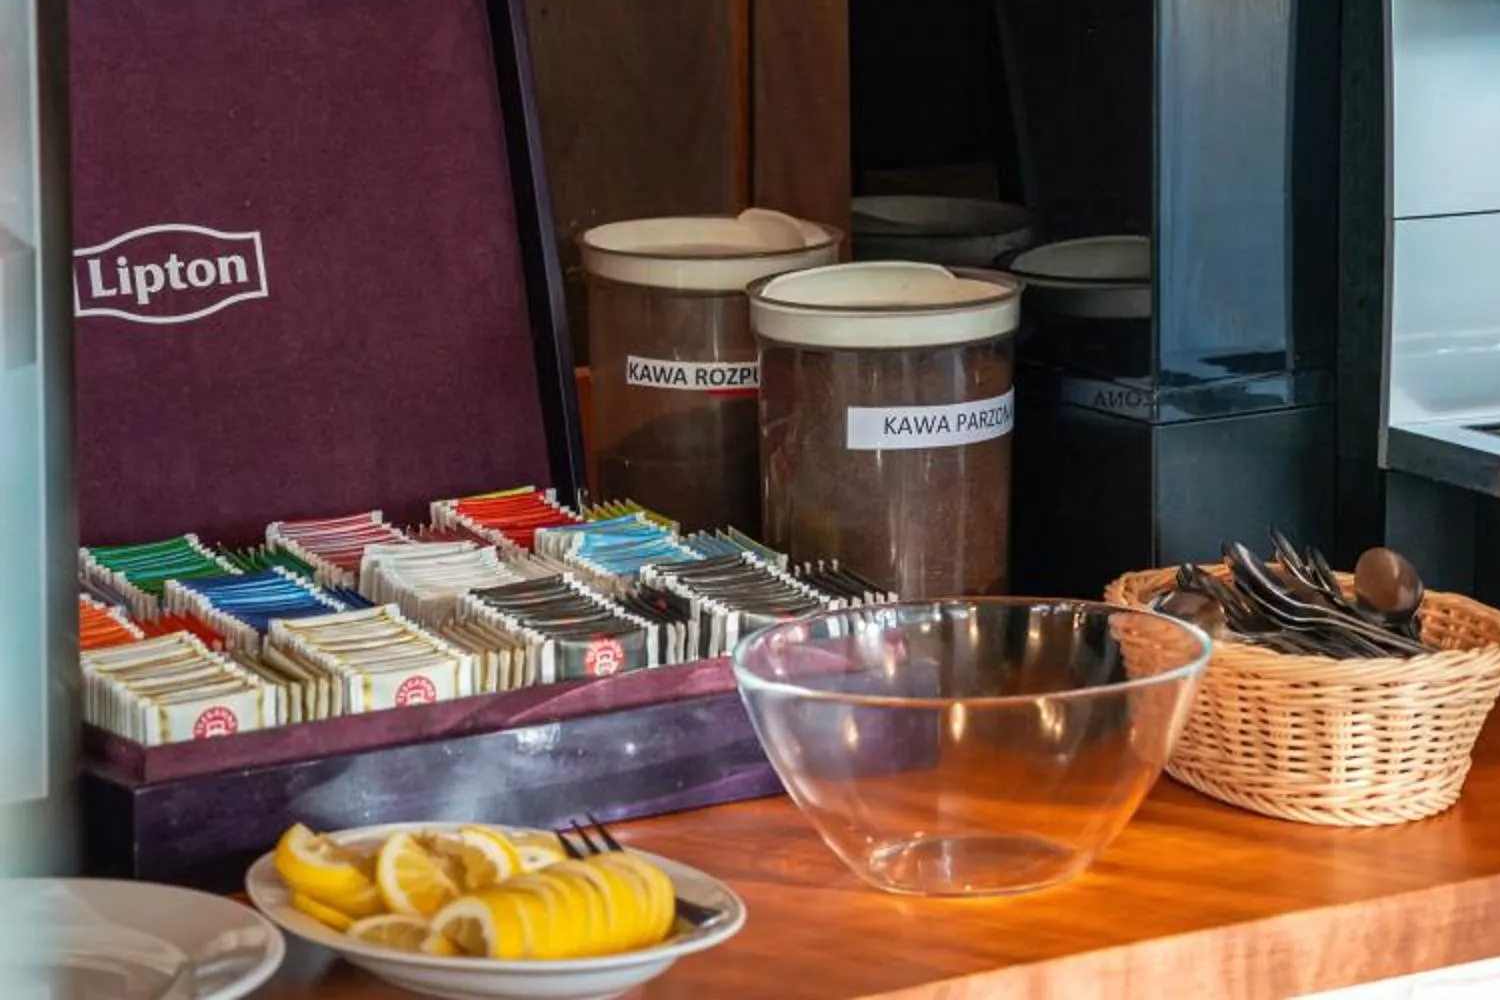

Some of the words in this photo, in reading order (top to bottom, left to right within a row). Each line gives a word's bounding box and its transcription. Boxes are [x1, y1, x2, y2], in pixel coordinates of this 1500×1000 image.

[87, 253, 249, 305] Lipton
[628, 362, 688, 386] KAWA
[883, 415, 952, 435] KAWA
